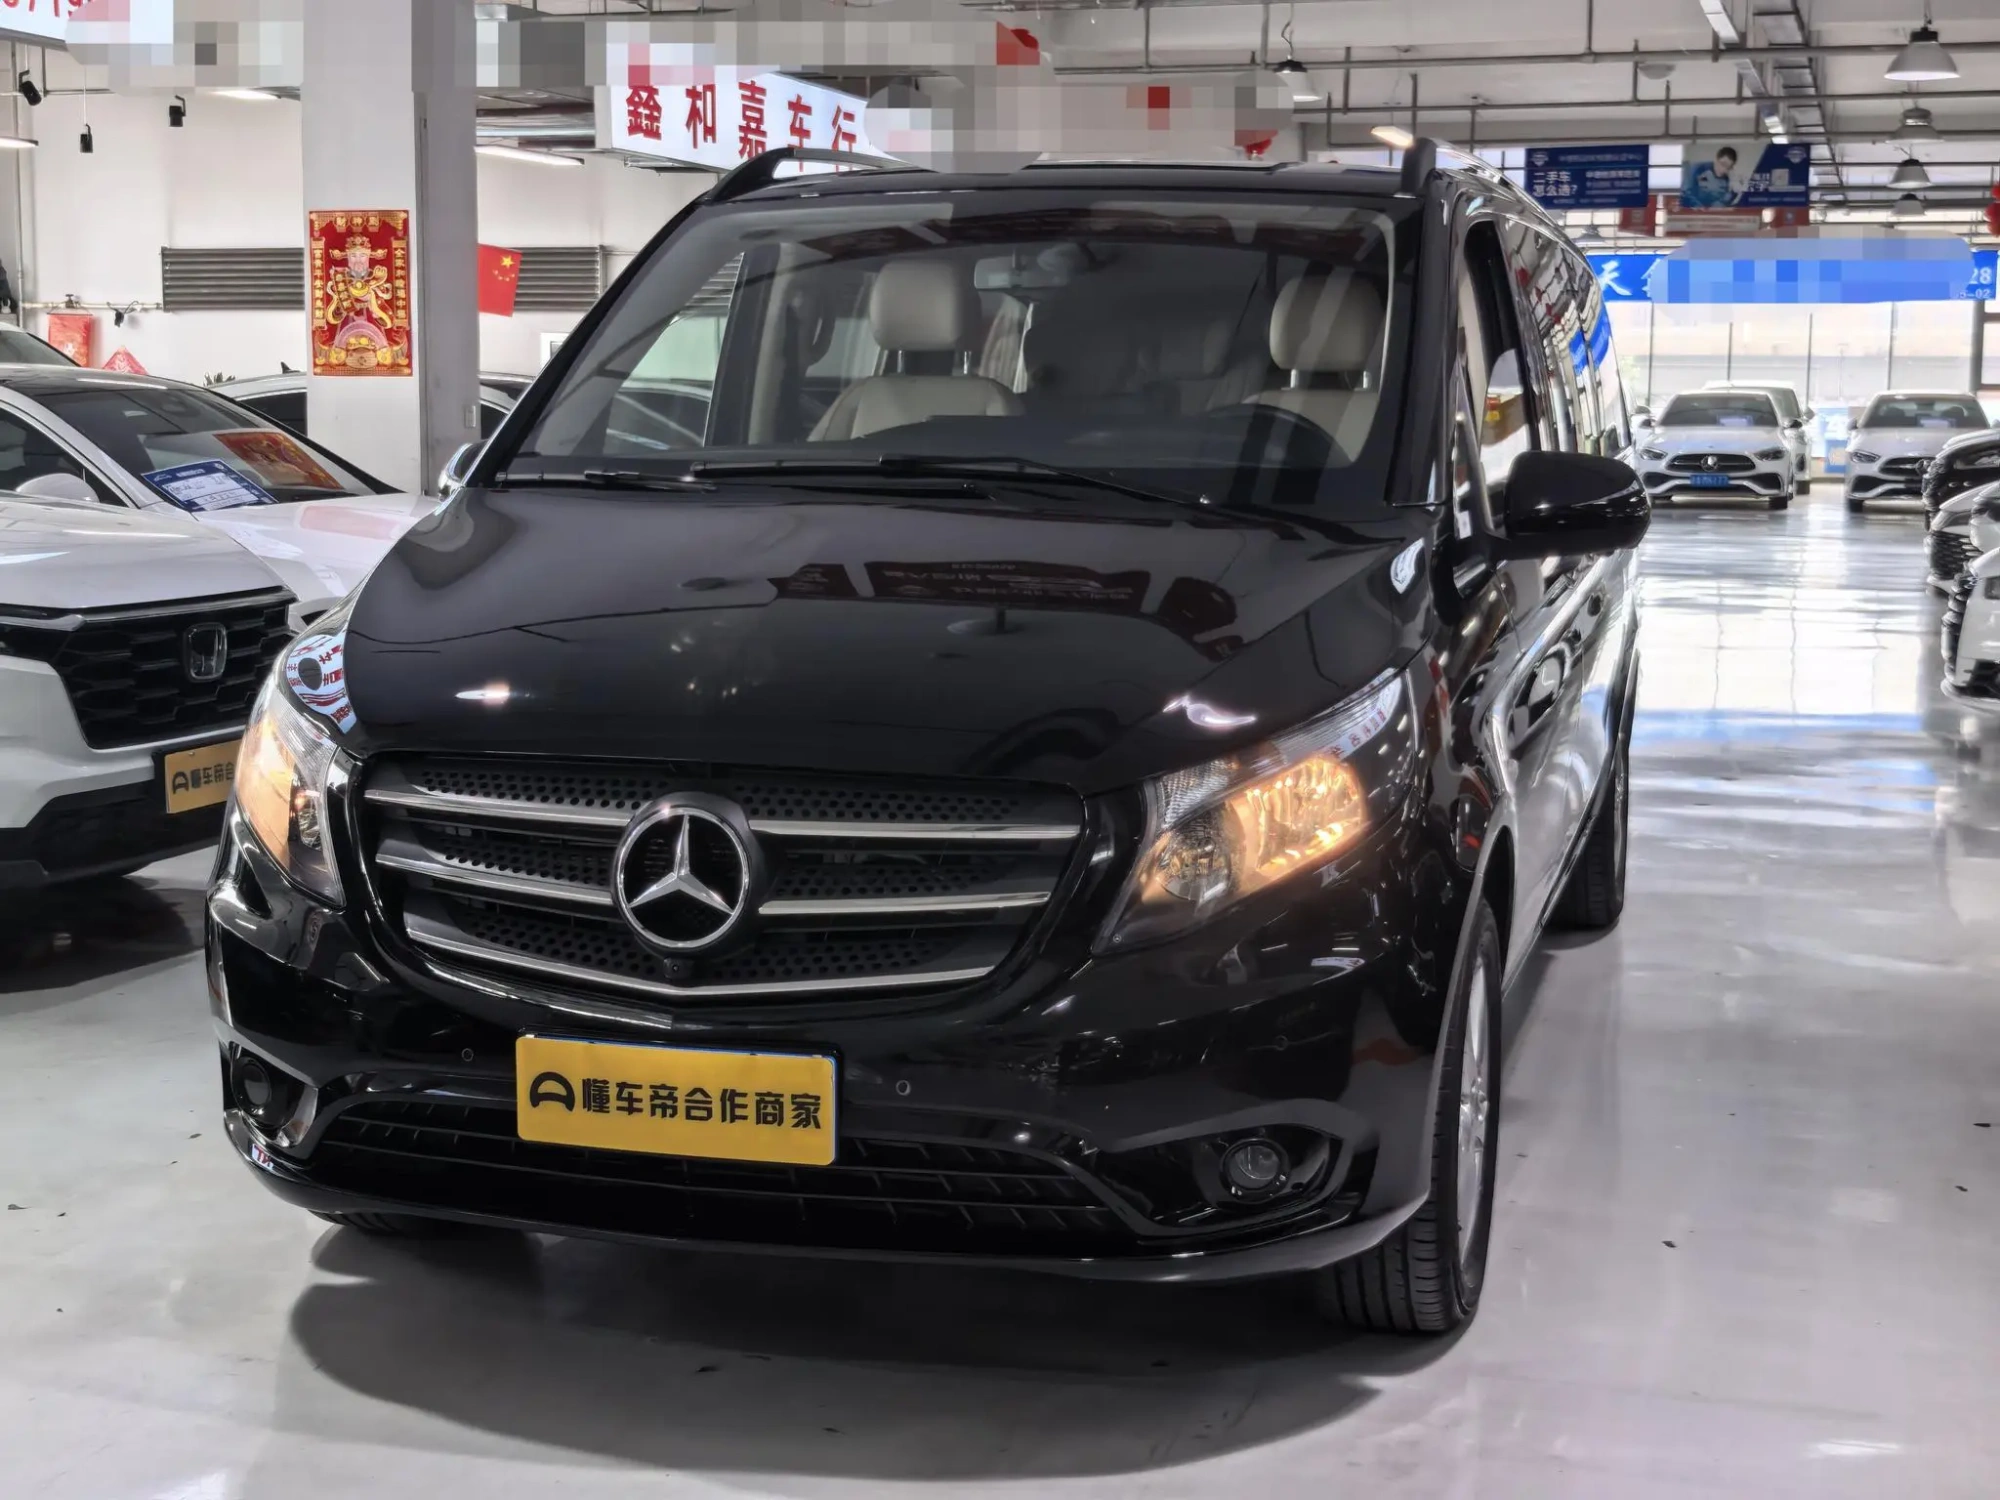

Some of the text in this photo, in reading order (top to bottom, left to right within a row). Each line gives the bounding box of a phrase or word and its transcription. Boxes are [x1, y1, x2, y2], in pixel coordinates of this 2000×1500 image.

[582, 1077, 821, 1130] 懂车帝合作商家
